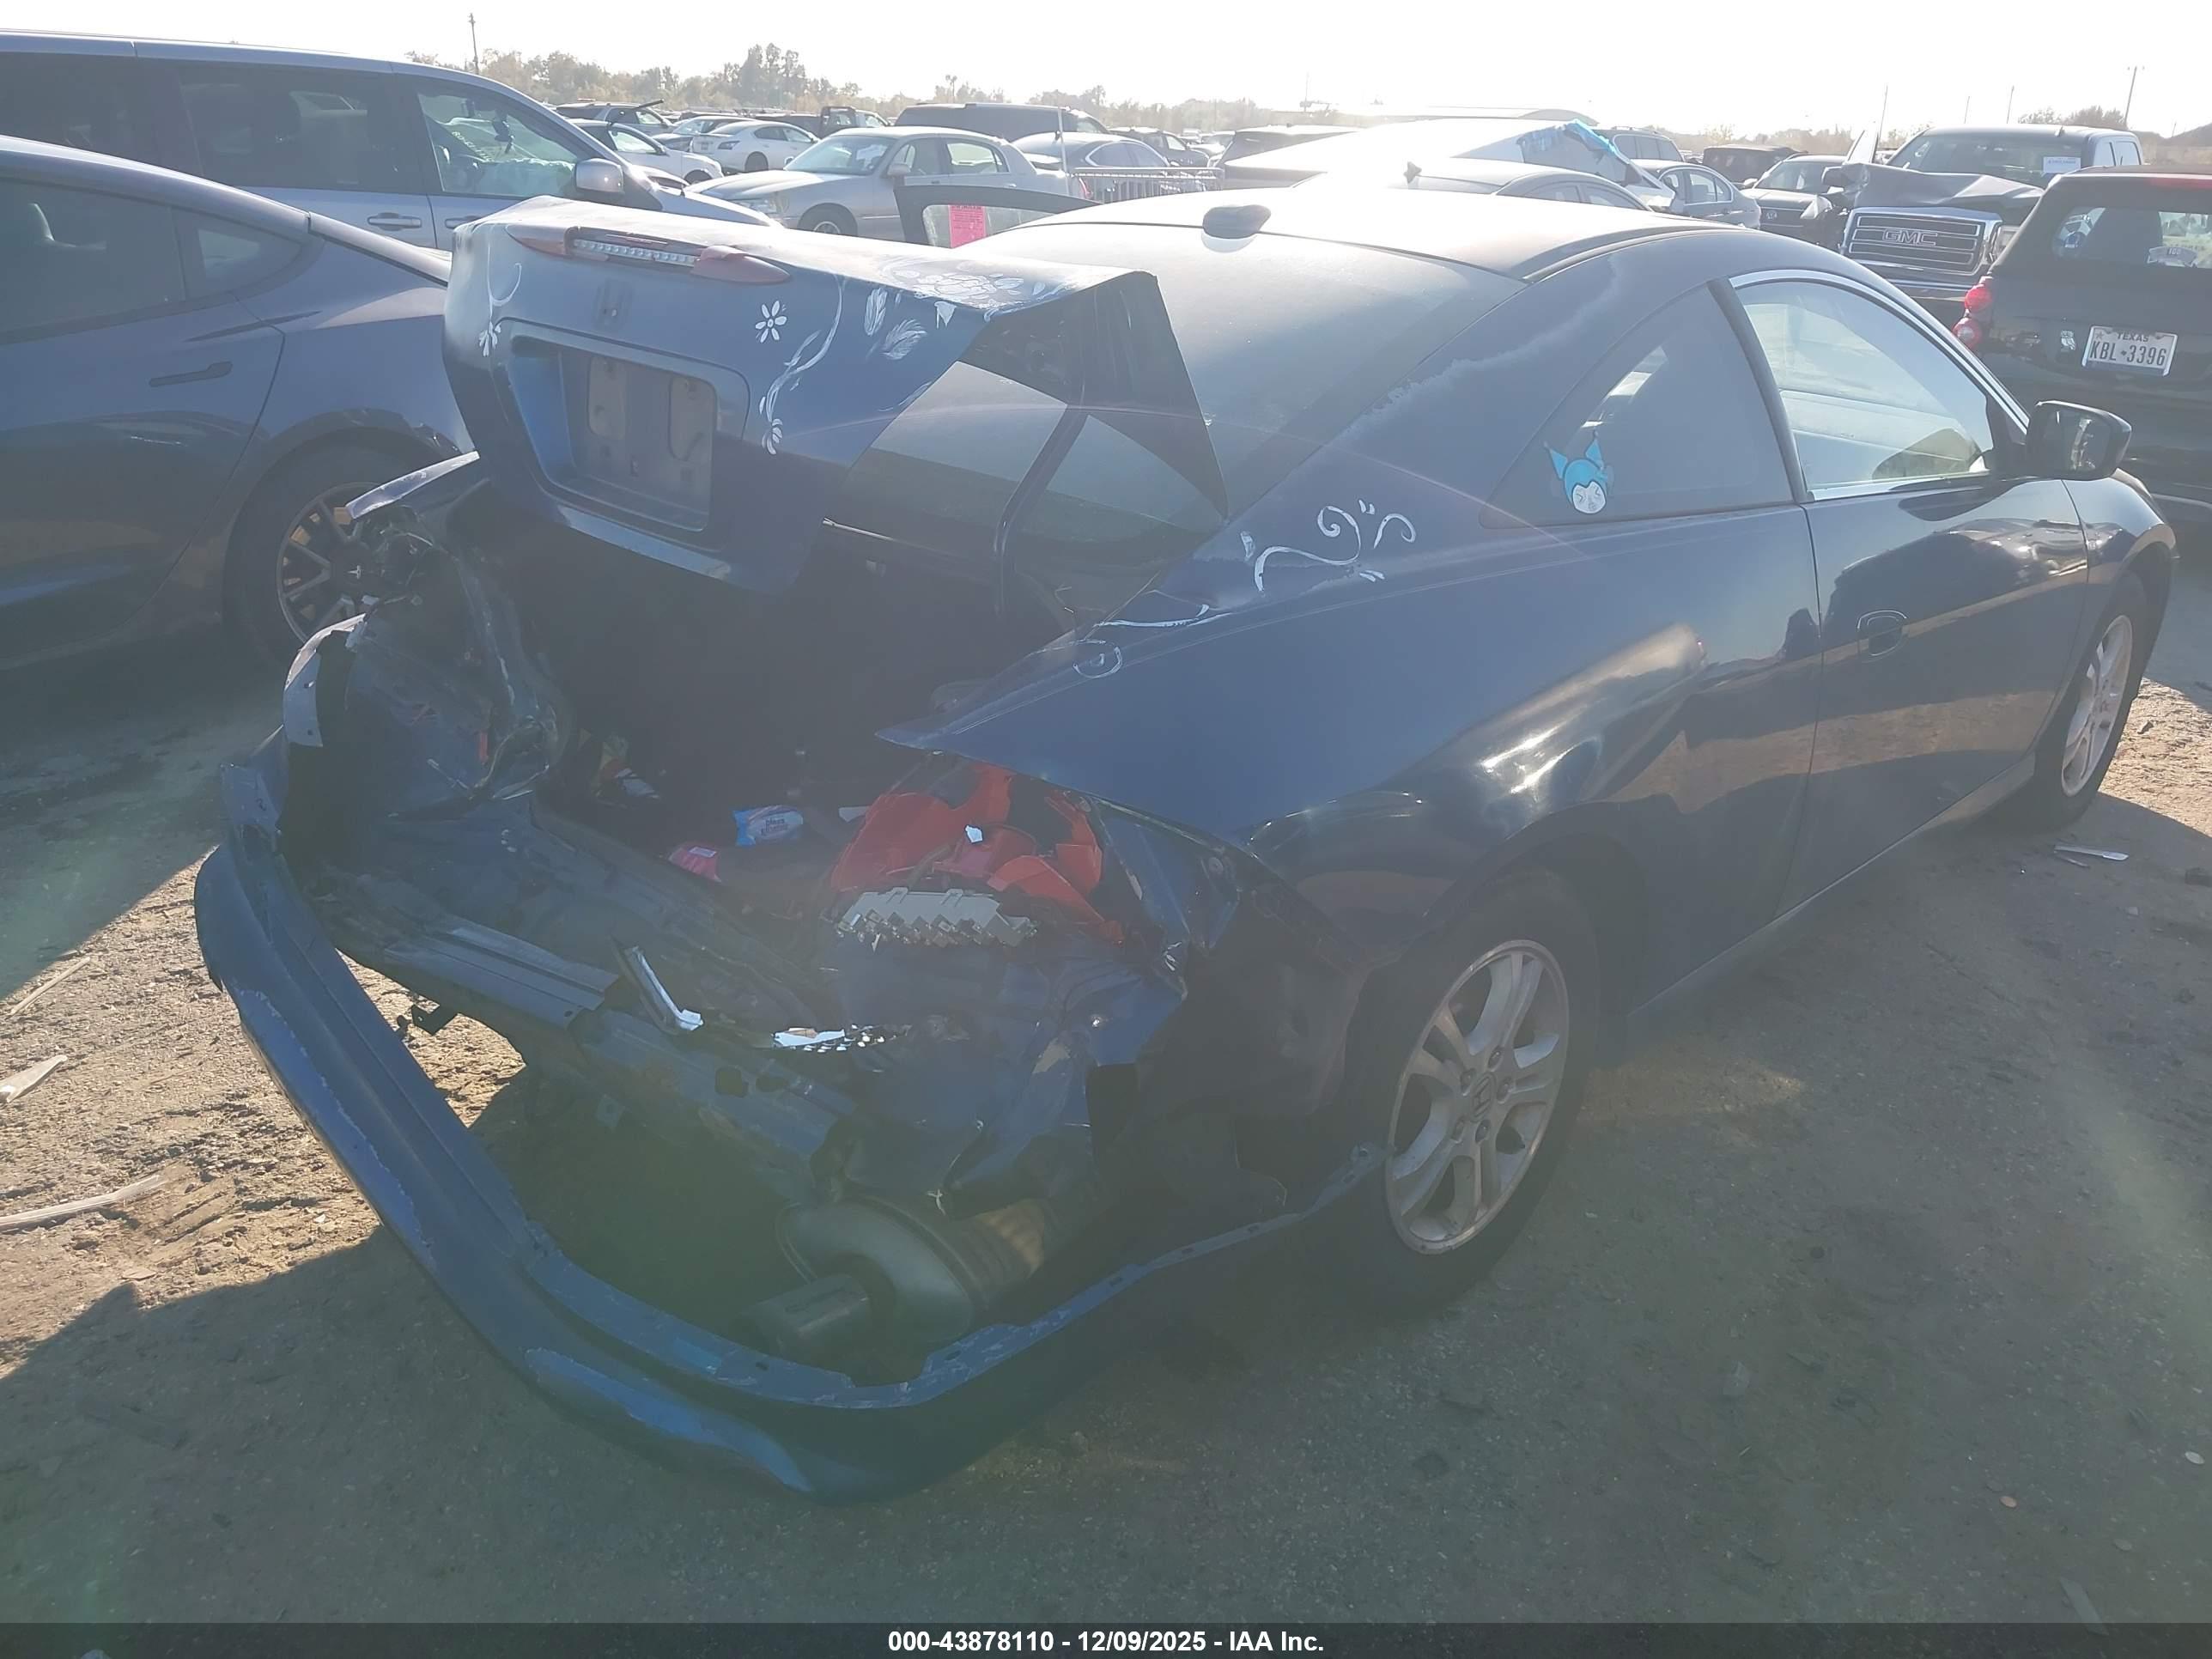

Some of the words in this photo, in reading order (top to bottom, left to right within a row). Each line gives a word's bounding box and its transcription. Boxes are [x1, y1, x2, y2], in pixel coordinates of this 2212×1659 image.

[1881, 228, 1938, 247] GMC
[2117, 332, 2149, 343] TEXAS
[2089, 341, 2117, 361] KBL
[2126, 344, 2167, 366] 3396
